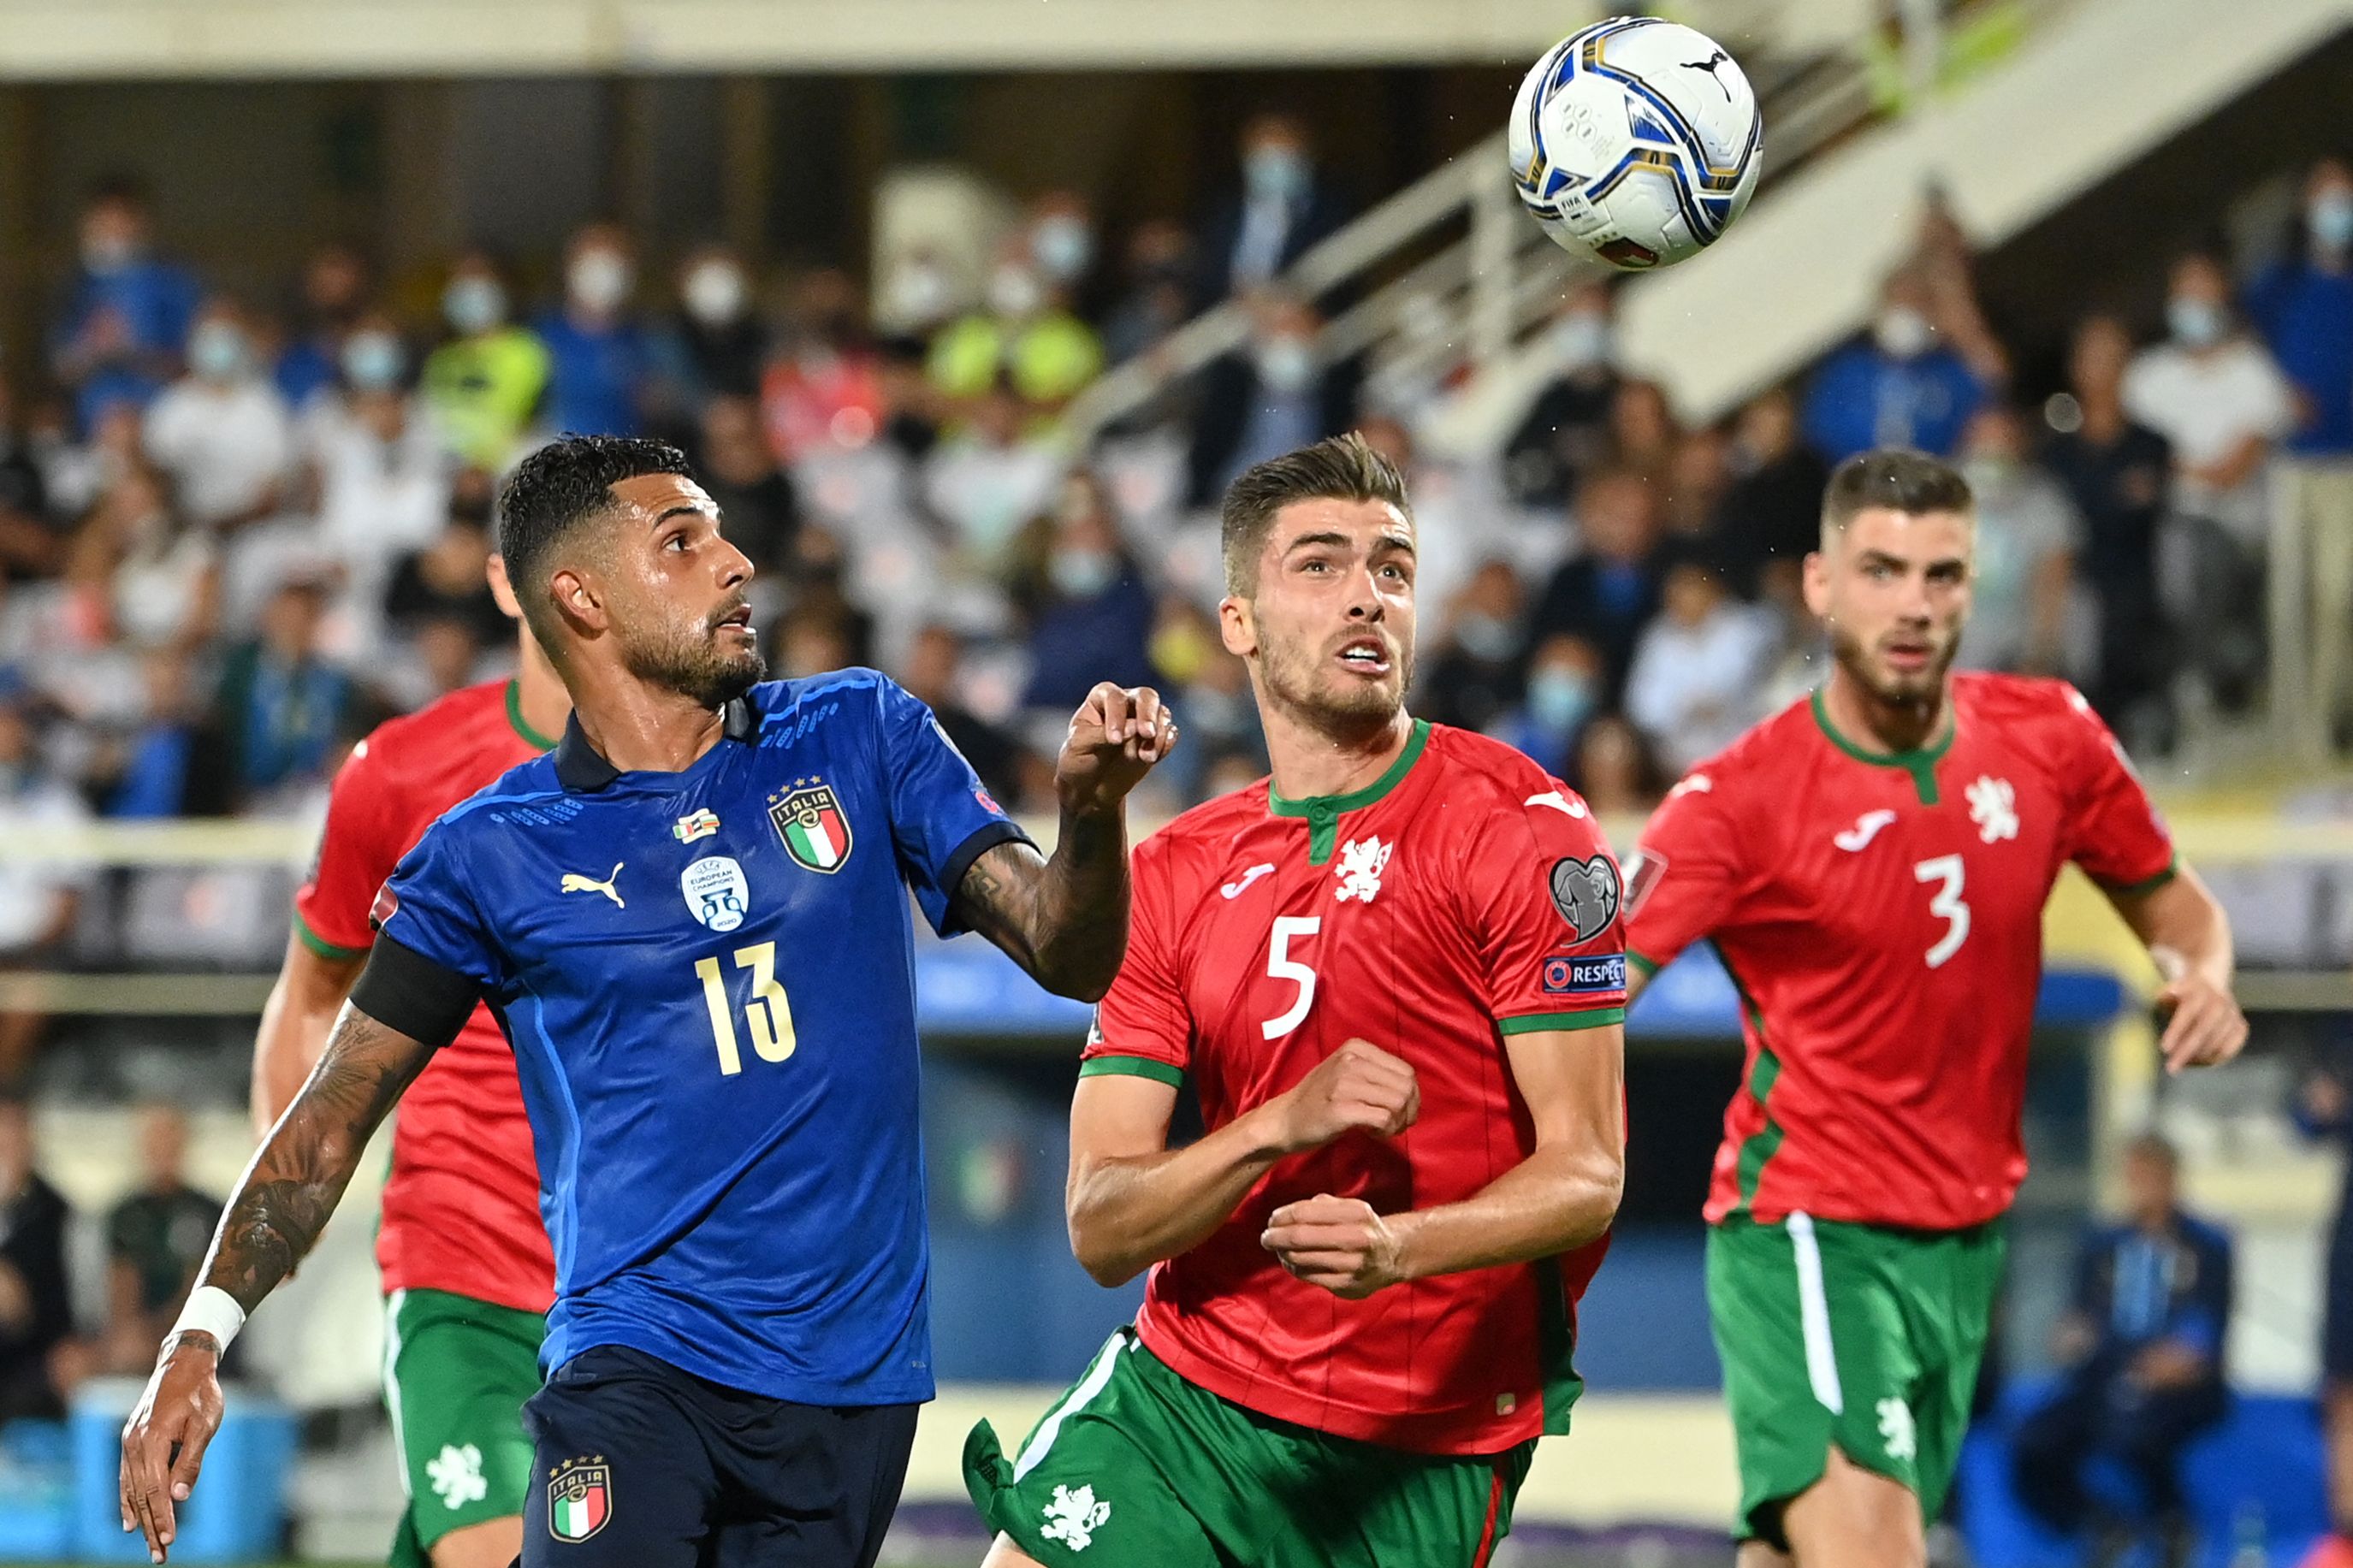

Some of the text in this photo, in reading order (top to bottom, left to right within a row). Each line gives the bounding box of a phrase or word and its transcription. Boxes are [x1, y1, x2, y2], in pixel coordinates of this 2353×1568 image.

[1562, 196, 1582, 210] FIFA
[776, 792, 829, 821] ITALIA
[690, 869, 732, 885] EUROPEAN
[696, 861, 720, 873] UEFA
[693, 876, 734, 891] CHAMPIONS
[1914, 854, 1971, 969] 3
[1261, 916, 1321, 1040] 5
[1574, 962, 1625, 983] RESPECT
[695, 941, 797, 1076] 13
[553, 1471, 602, 1496] ITALIA
